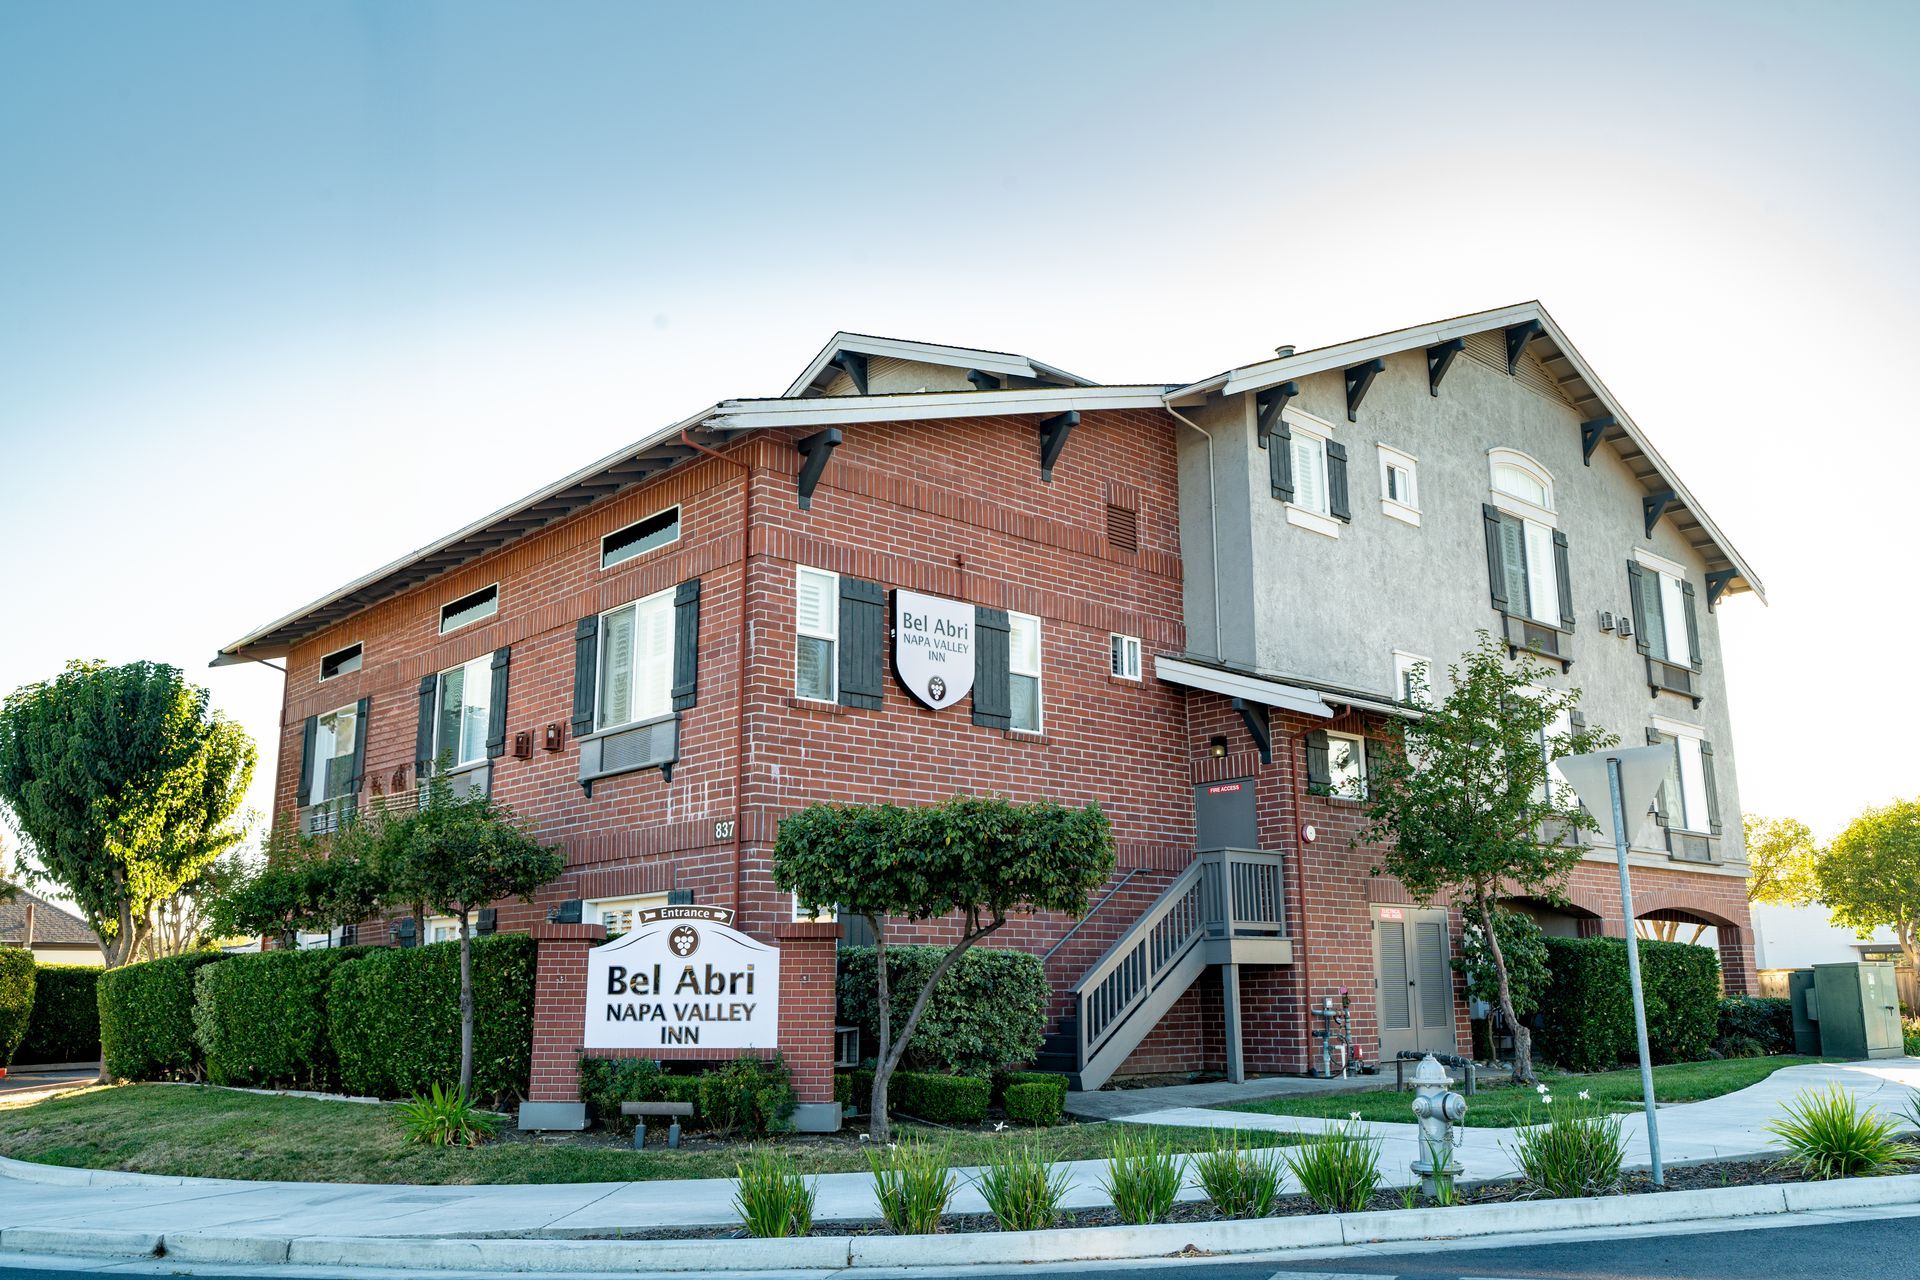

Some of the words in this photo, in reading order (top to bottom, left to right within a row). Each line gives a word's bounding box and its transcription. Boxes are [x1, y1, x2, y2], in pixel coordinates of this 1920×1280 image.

[903, 612, 928, 632] Bel
[934, 618, 968, 640] Abri
[903, 633, 931, 648] NAPA
[933, 638, 969, 654] VALLEY
[928, 650, 946, 663] INN
[715, 821, 735, 838] 837
[660, 908, 710, 919] Entrance
[607, 963, 661, 995] Bel
[674, 963, 755, 995] Abri
[606, 1003, 667, 1022] NAPA
[673, 1003, 756, 1022] VALLEY
[660, 1026, 700, 1045] INN
